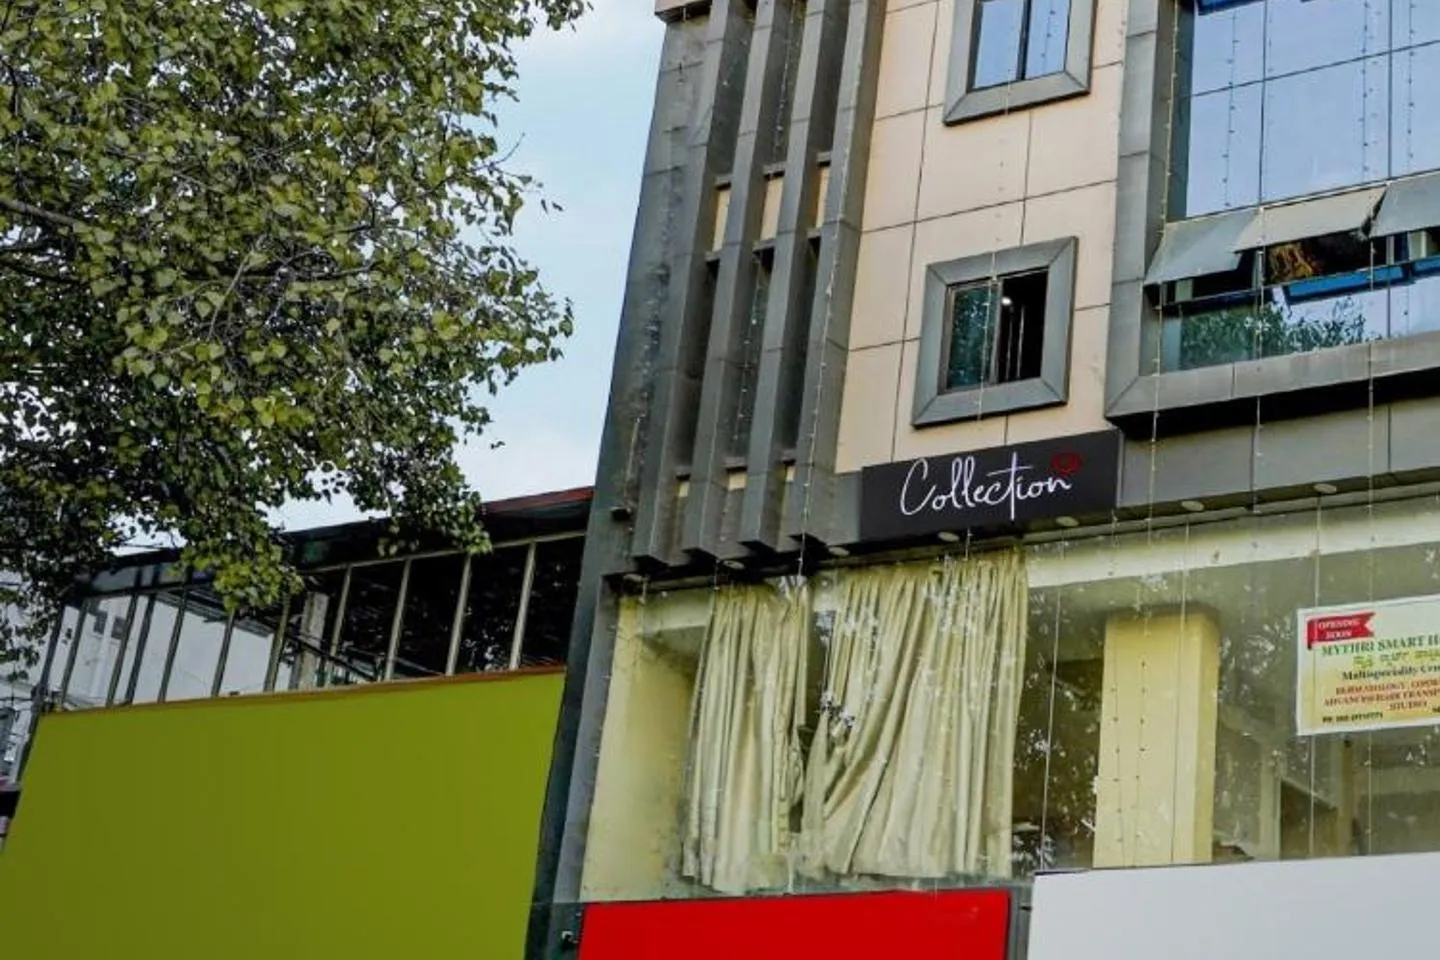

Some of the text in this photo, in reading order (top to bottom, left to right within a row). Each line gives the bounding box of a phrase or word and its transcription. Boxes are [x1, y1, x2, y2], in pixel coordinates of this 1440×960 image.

[900, 451, 1073, 521] Collection
[1321, 641, 1374, 657] MYTHRI
[1378, 635, 1424, 651] SMART
